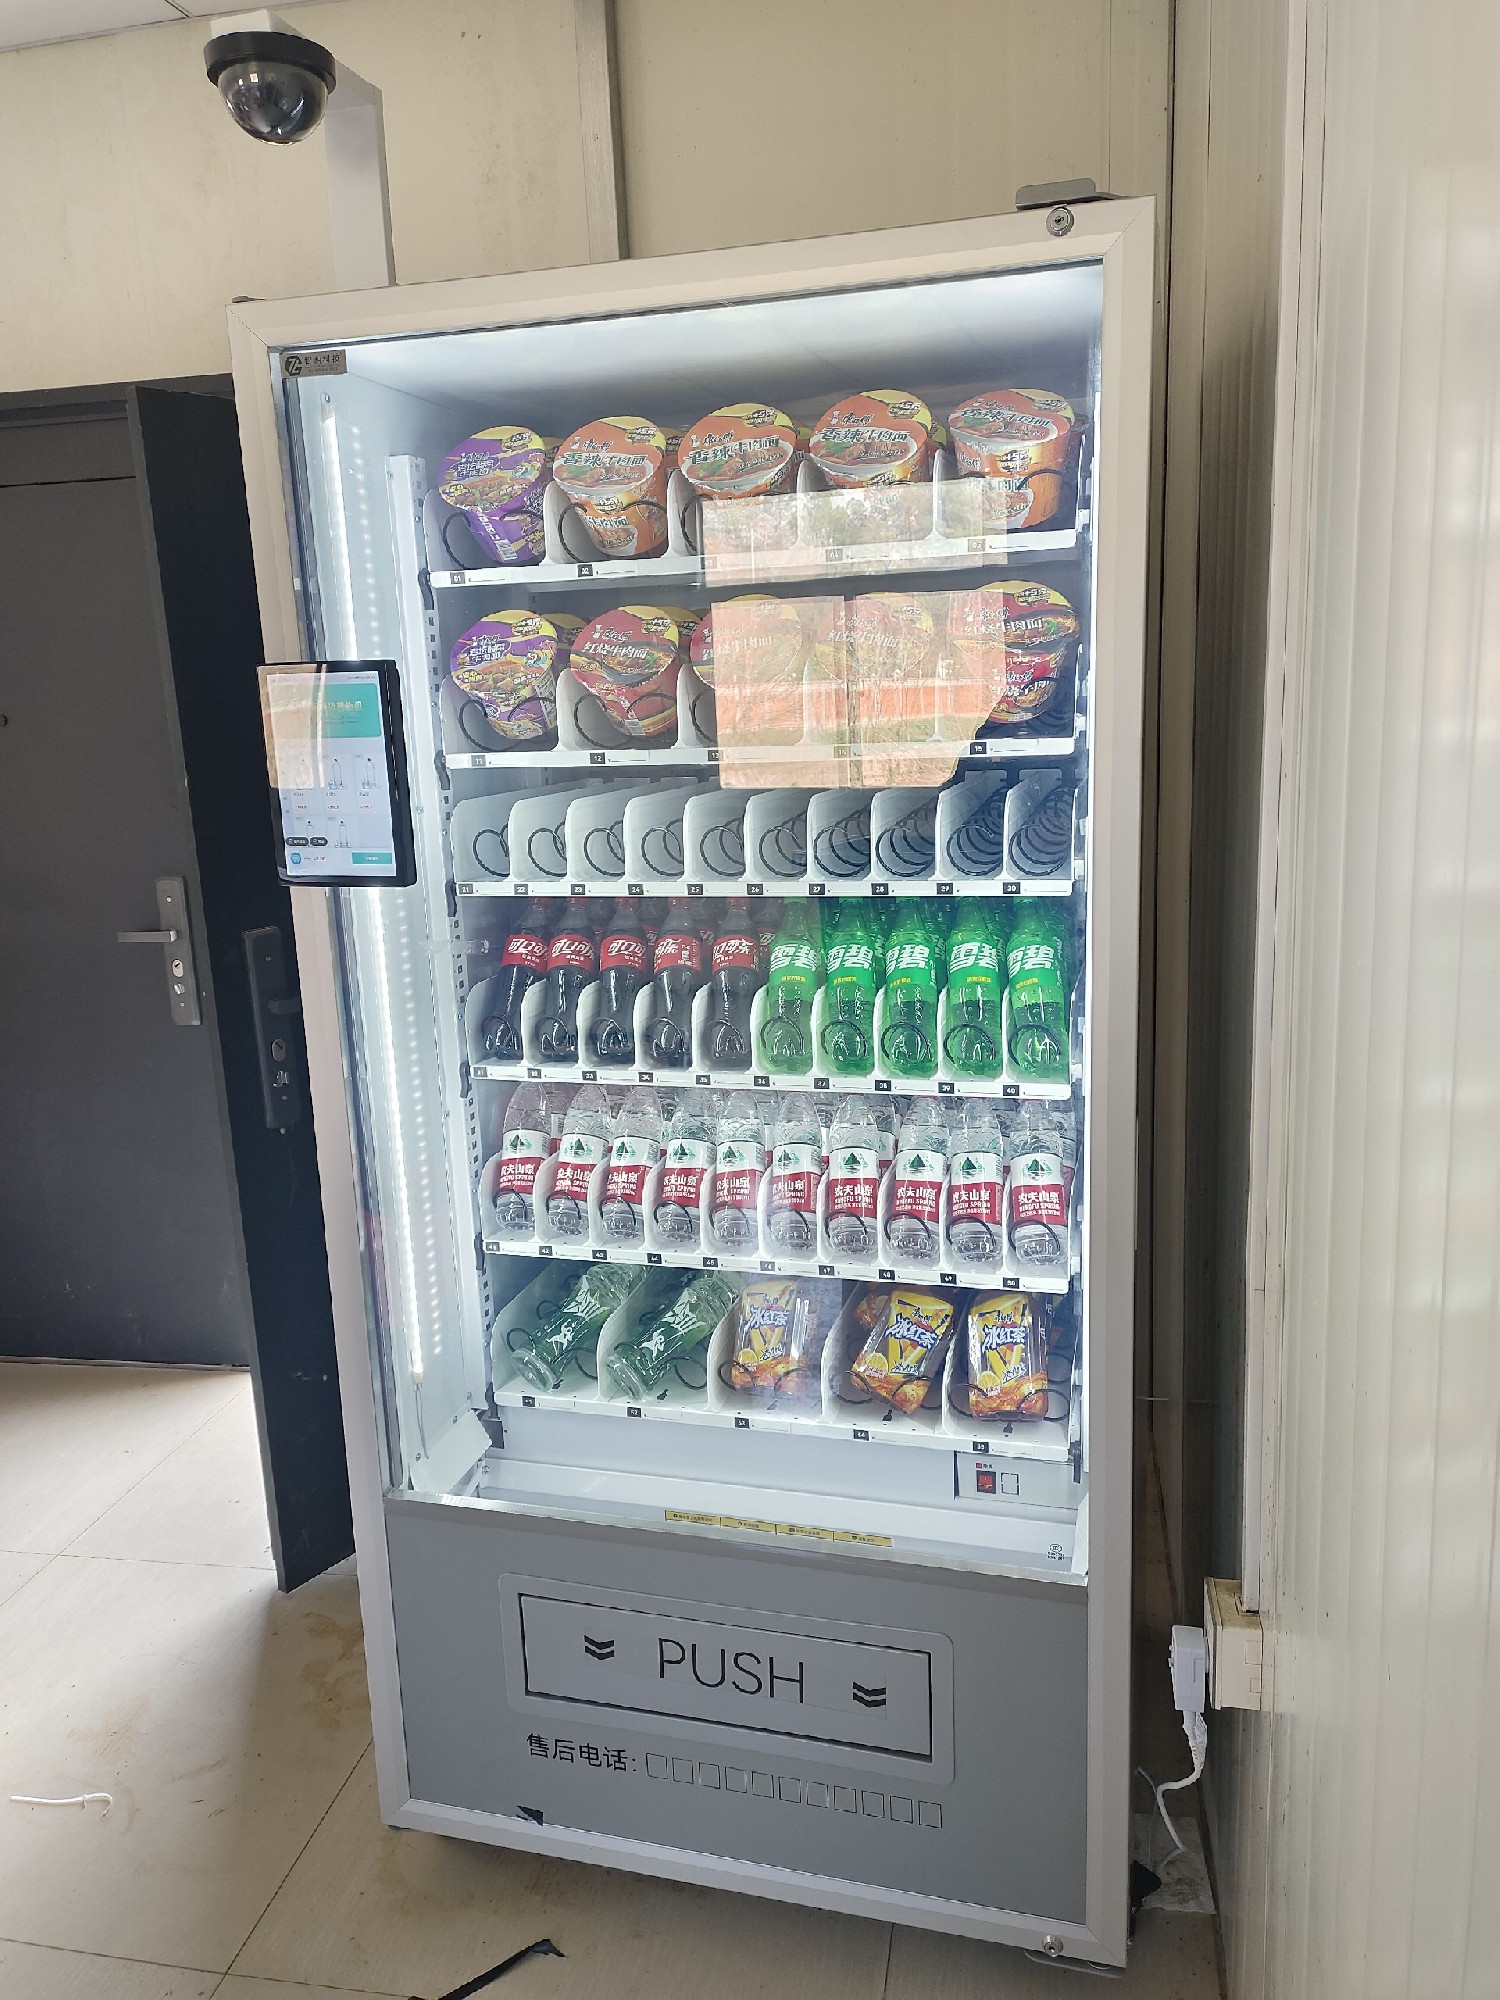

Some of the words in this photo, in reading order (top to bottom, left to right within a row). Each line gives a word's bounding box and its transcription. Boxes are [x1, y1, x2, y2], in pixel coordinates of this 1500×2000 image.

[961, 407, 1054, 426] 香辣牛肉面
[816, 427, 910, 442] 香辣牛肉面
[562, 452, 648, 467] 香辣牛肉面
[684, 435, 780, 464] 香辣牛肉面
[828, 630, 900, 647] 红烧牛肉面
[964, 617, 1043, 635] 红烧牛肉面
[582, 642, 650, 659] 红烧牛肉面
[769, 943, 818, 974] 雪碧
[827, 944, 874, 974] 雪碧
[886, 944, 931, 978] 雪碧
[949, 942, 999, 974] 雪碧
[1007, 944, 1055, 979] 雪碧
[835, 1184, 873, 1196] 农夫山泉
[897, 1186, 937, 1199] 农夫山泉
[1018, 1191, 1060, 1204] 农夫山泉
[745, 1305, 789, 1334] 冰红茶
[982, 1324, 1026, 1353] 冰红茶
[658, 1637, 804, 1704] PUSH
[526, 1733, 637, 1772] 售后电话:
